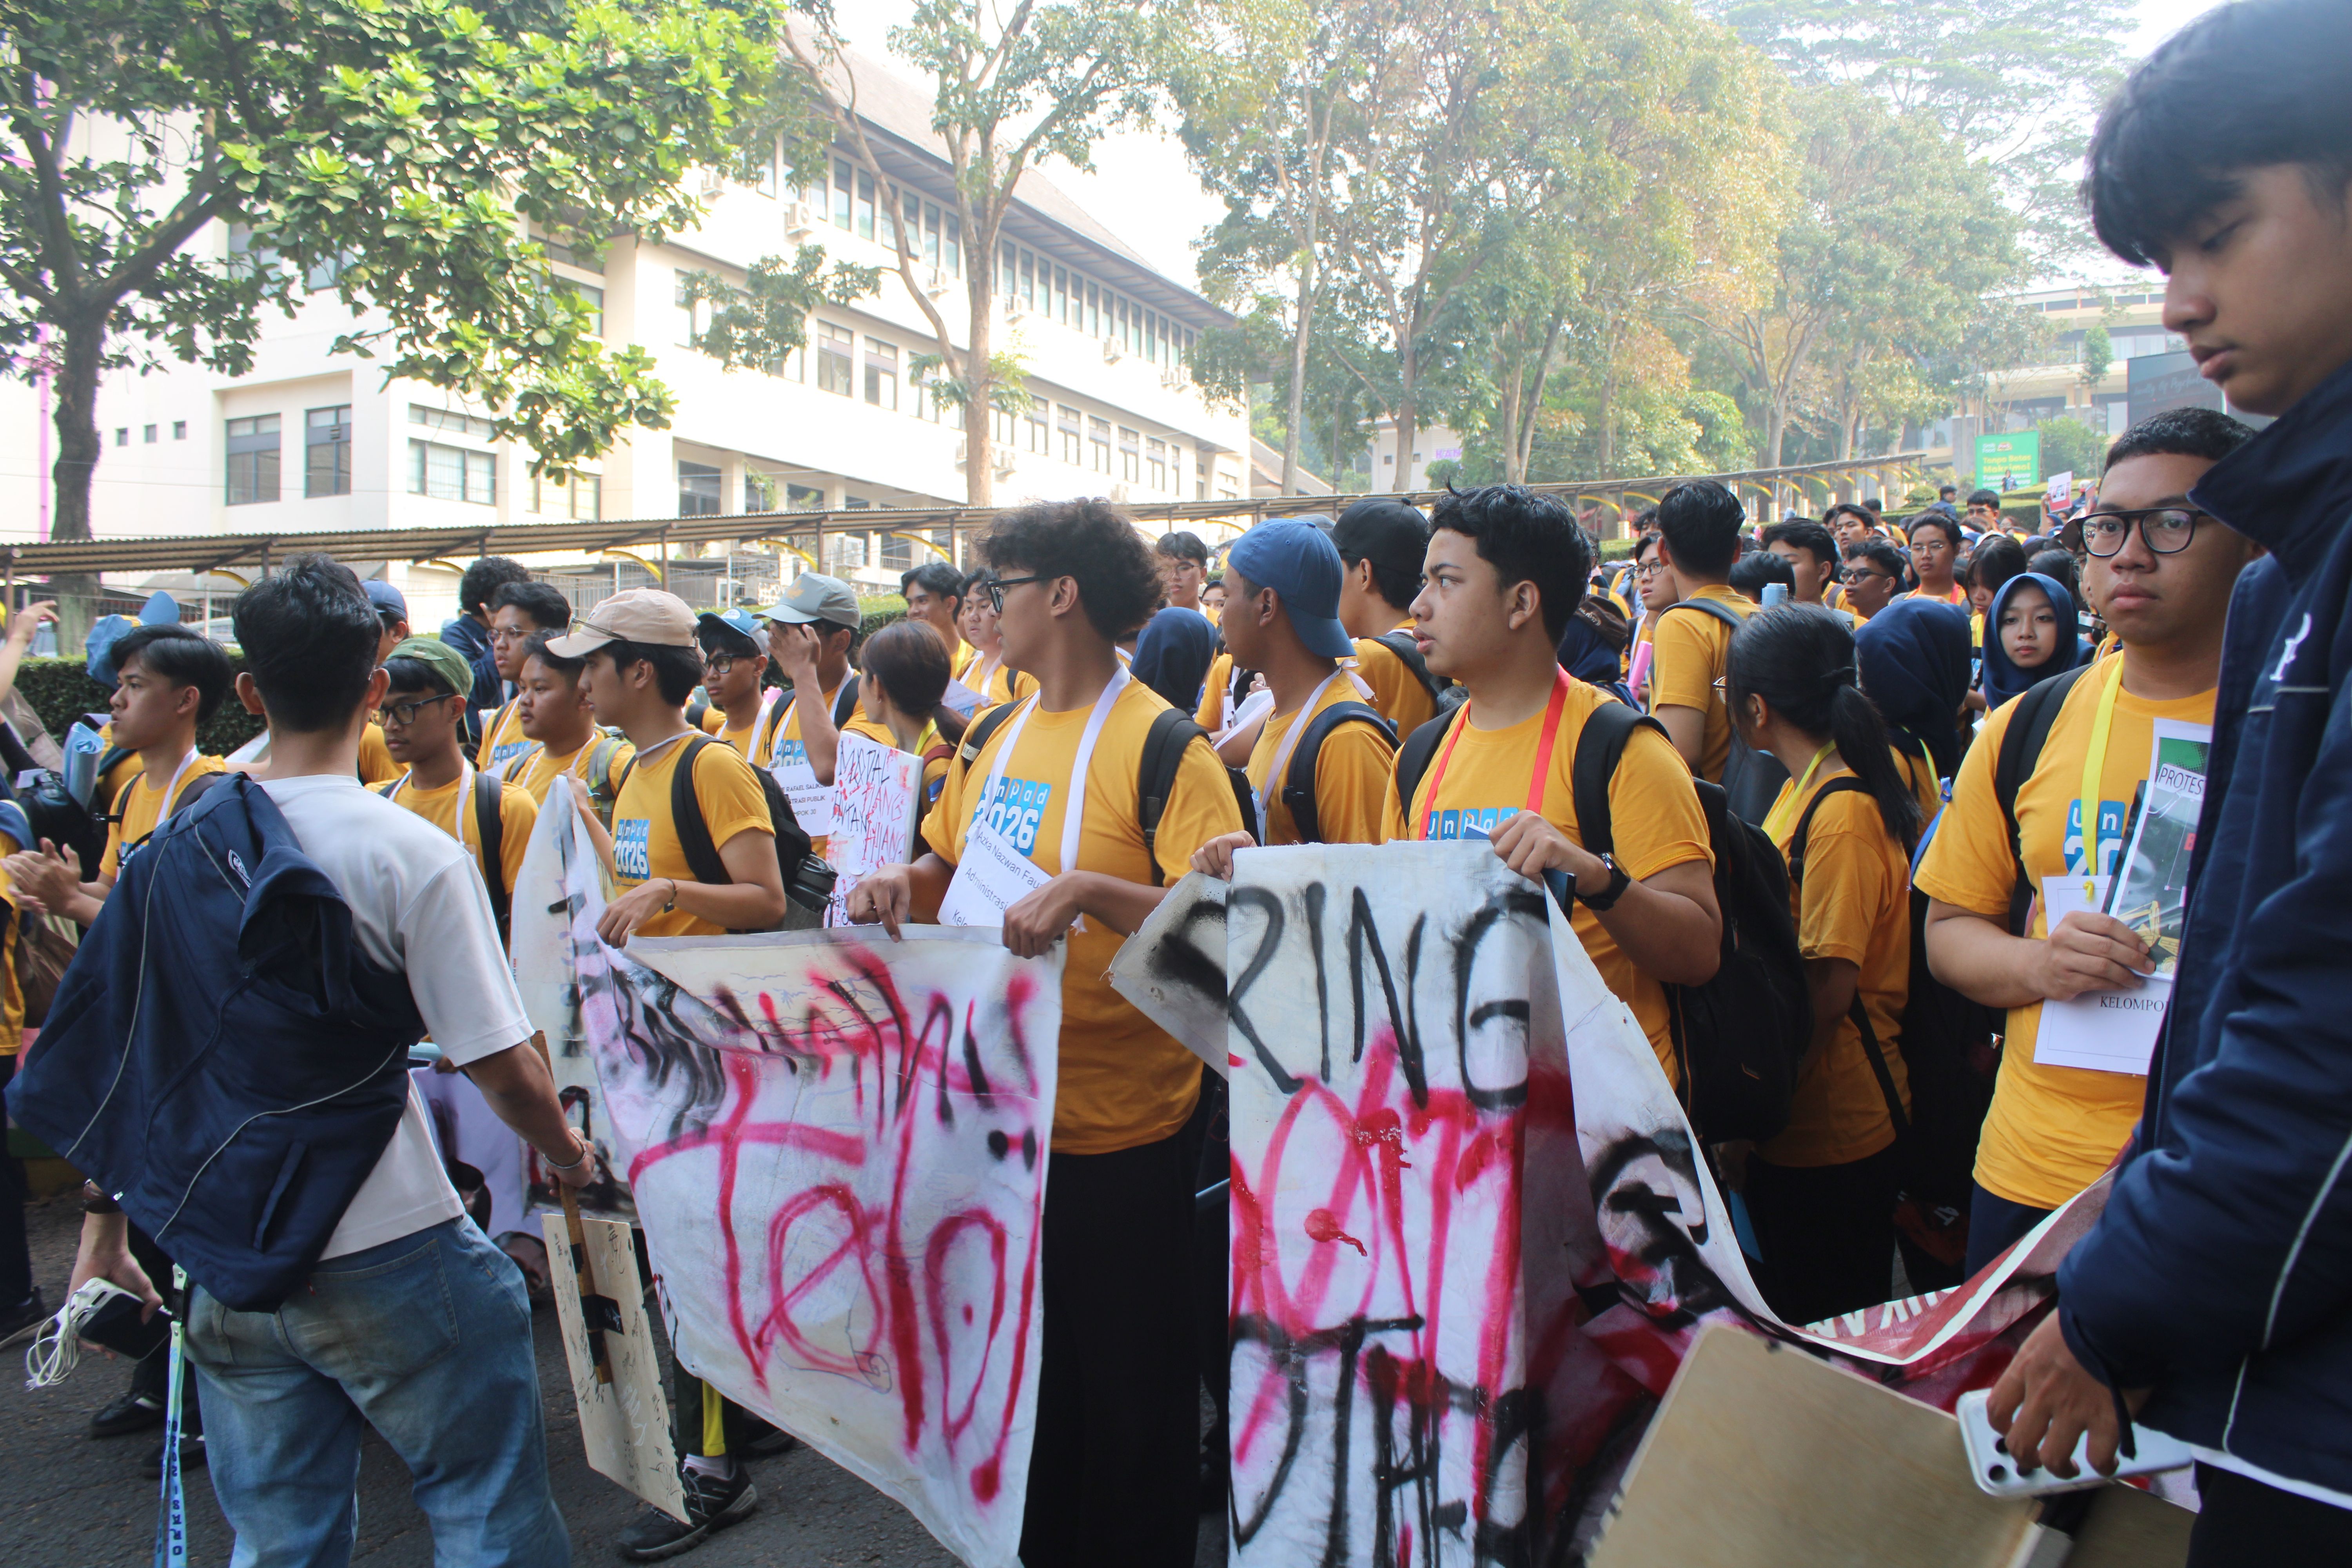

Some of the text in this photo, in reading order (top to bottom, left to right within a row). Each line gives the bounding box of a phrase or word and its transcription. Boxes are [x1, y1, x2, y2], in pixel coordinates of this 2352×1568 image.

[1983, 456, 2007, 465] Tanpa
[617, 822, 648, 840] unpad
[613, 840, 648, 875] 2026
[976, 831, 992, 851] Azka
[991, 844, 1022, 877] Nazwan
[965, 867, 1009, 912] Administrasi
